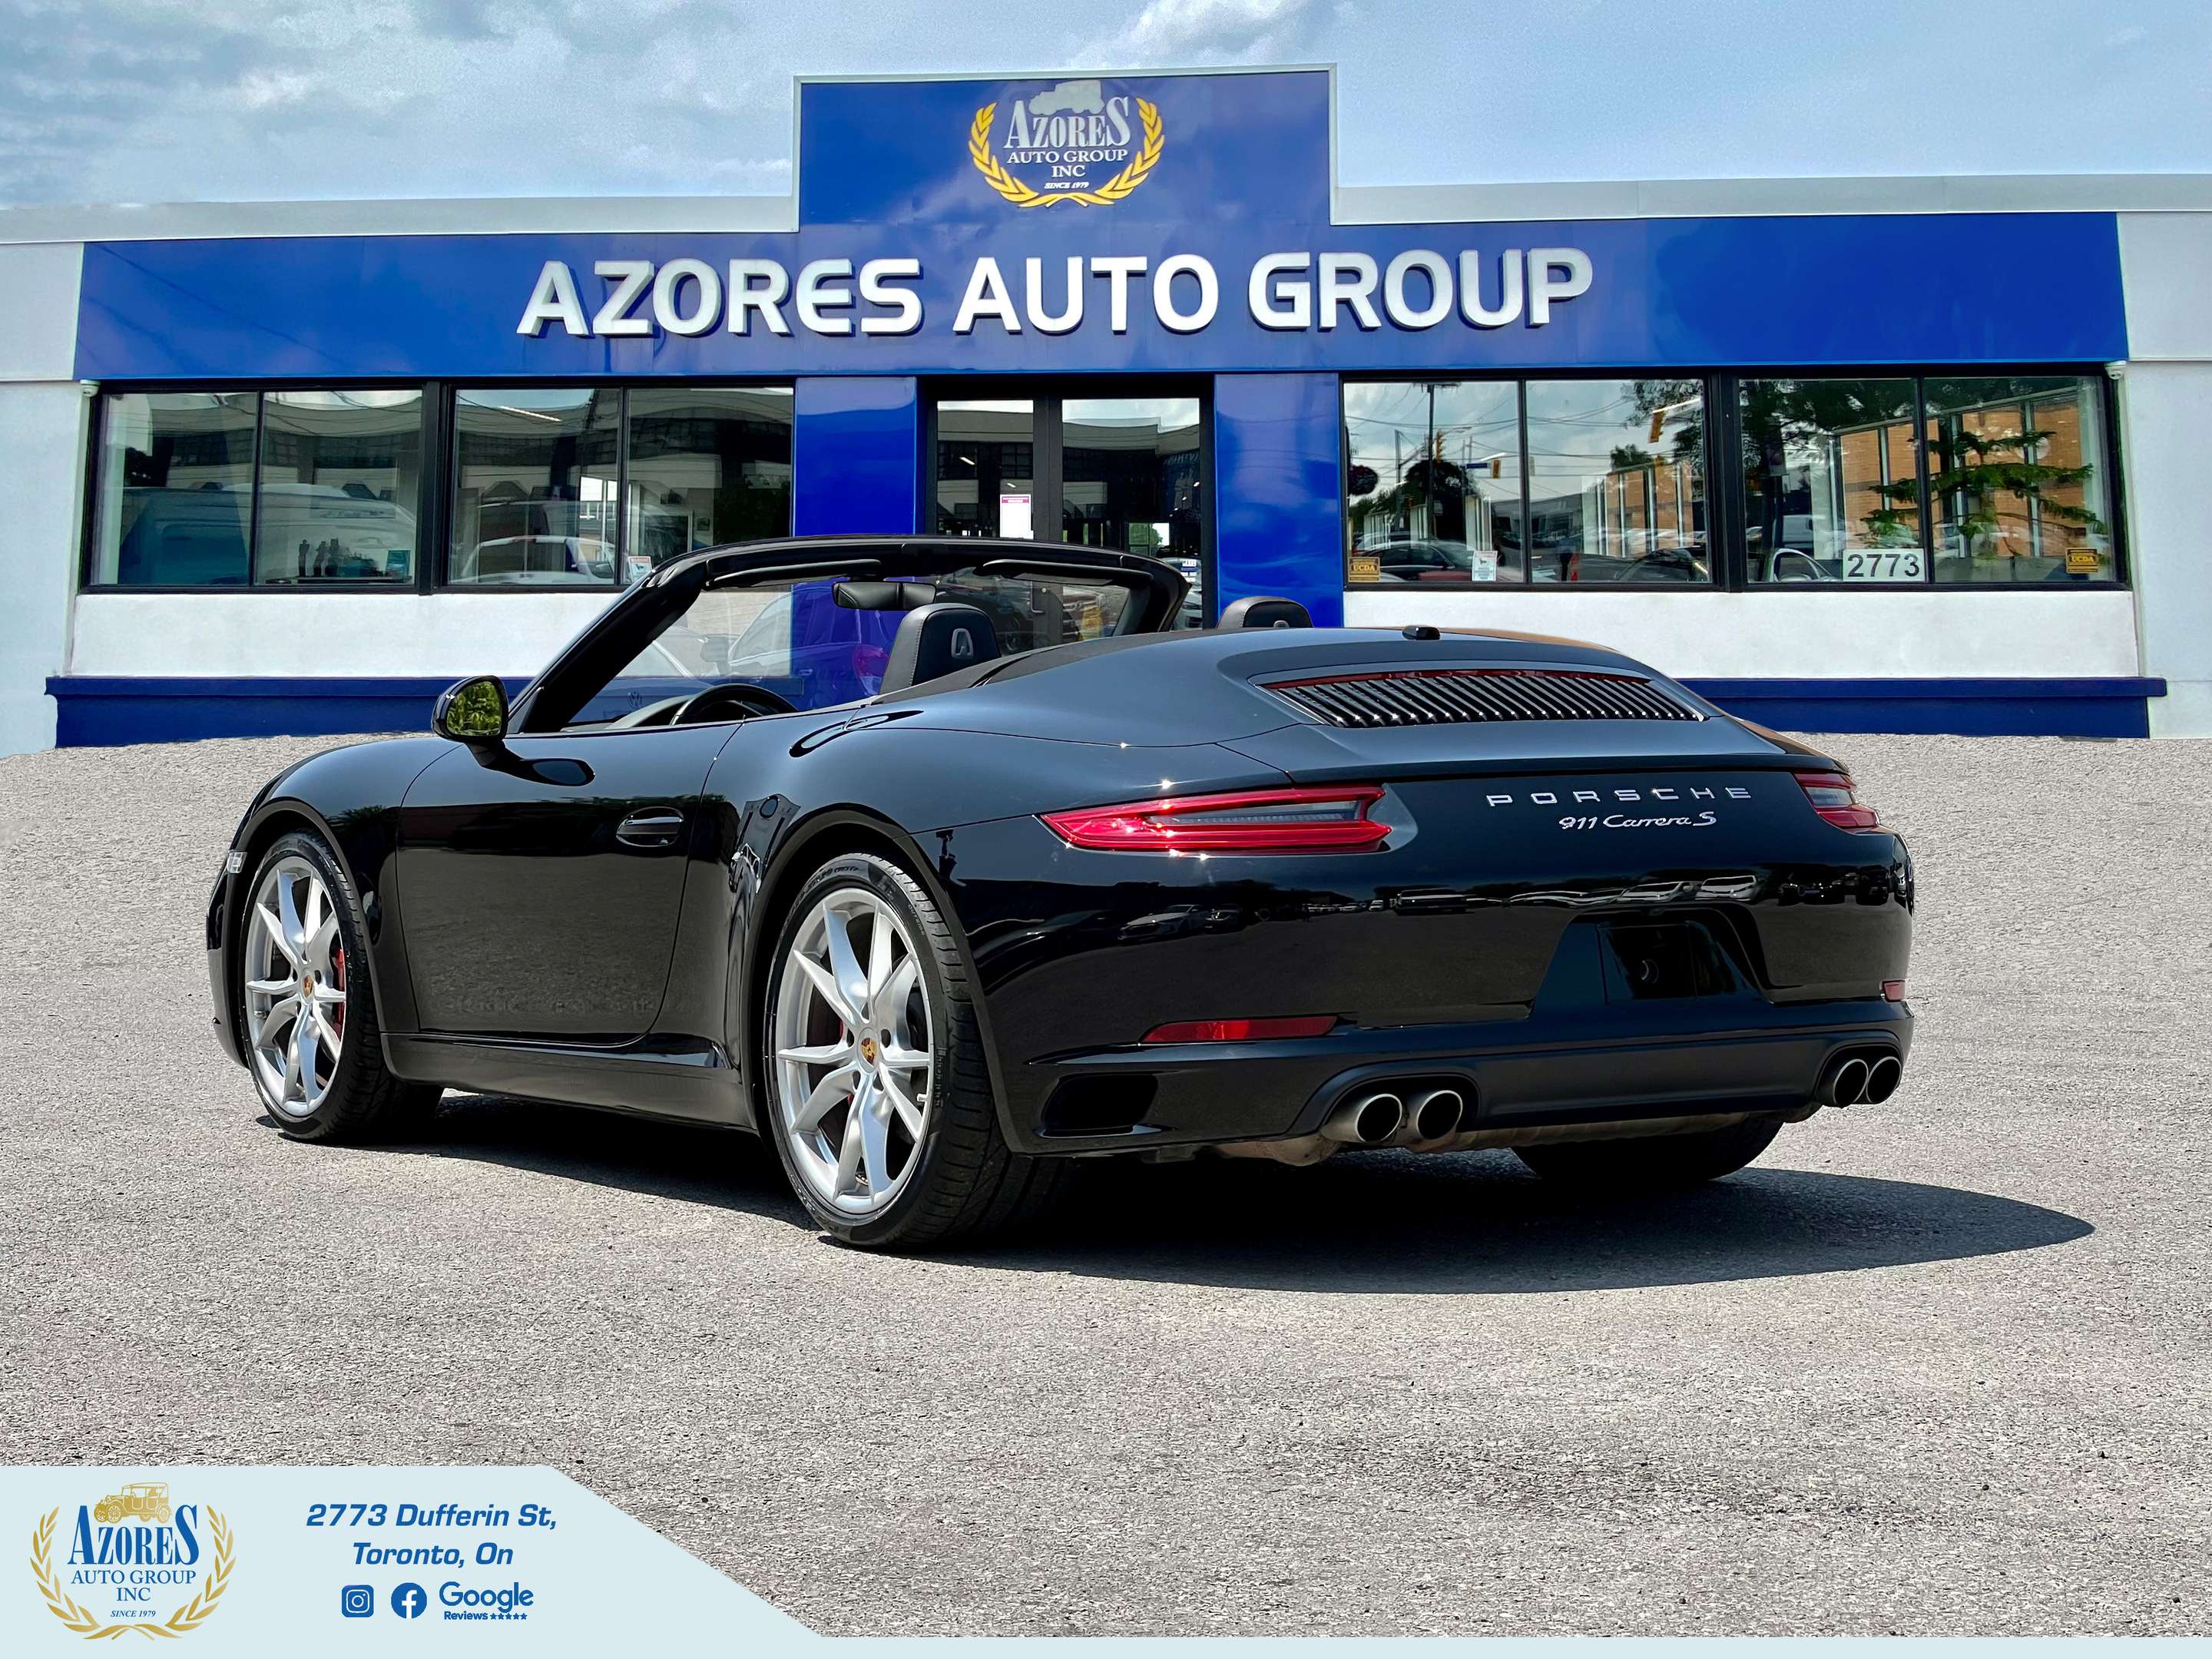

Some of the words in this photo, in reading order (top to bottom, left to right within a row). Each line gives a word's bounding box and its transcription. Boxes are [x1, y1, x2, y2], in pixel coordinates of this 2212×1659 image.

[1004, 97, 1131, 149] AZORES
[1007, 151, 1060, 164] AUTO
[1063, 149, 1128, 164] GROUP
[1051, 165, 1086, 177] INC
[516, 258, 922, 336] AZORES
[952, 253, 1220, 334] AUTO
[1248, 247, 1593, 330] GROUP
[1847, 553, 1920, 578] 2773
[1485, 786, 1752, 806] PORSCHE
[1558, 816, 1598, 830] 911
[1602, 813, 1691, 830] Carrera
[1692, 811, 1717, 826] S
